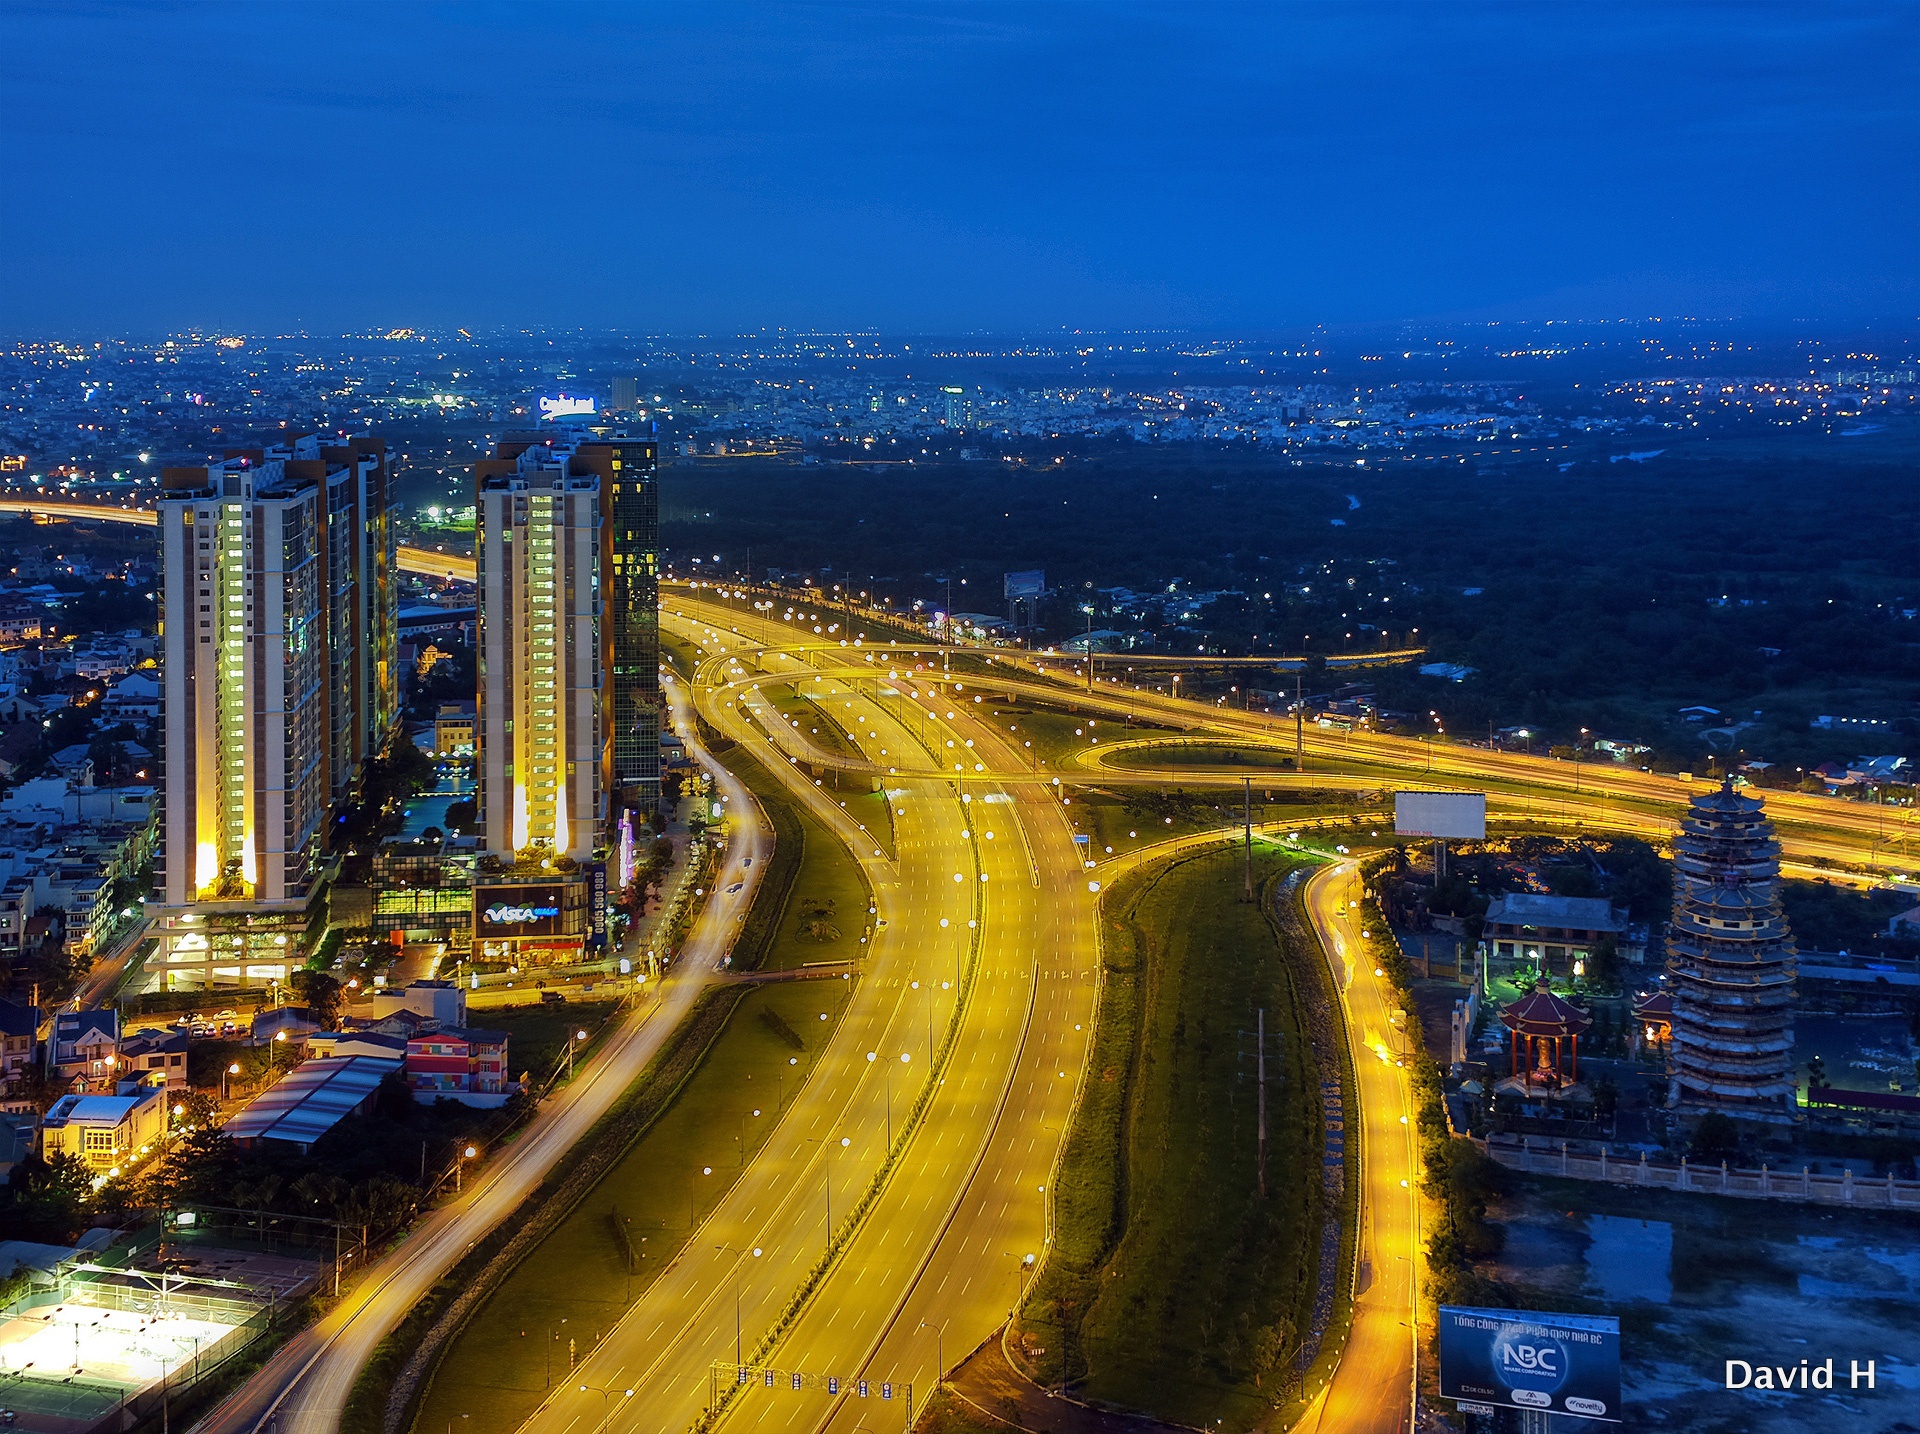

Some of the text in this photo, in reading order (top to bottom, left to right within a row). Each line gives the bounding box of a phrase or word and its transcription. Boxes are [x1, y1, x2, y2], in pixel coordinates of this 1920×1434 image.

[595, 871, 604, 934] 0905 560 989
[1504, 1343, 1557, 1370] NBC
[1575, 1400, 1603, 1413] novelty
